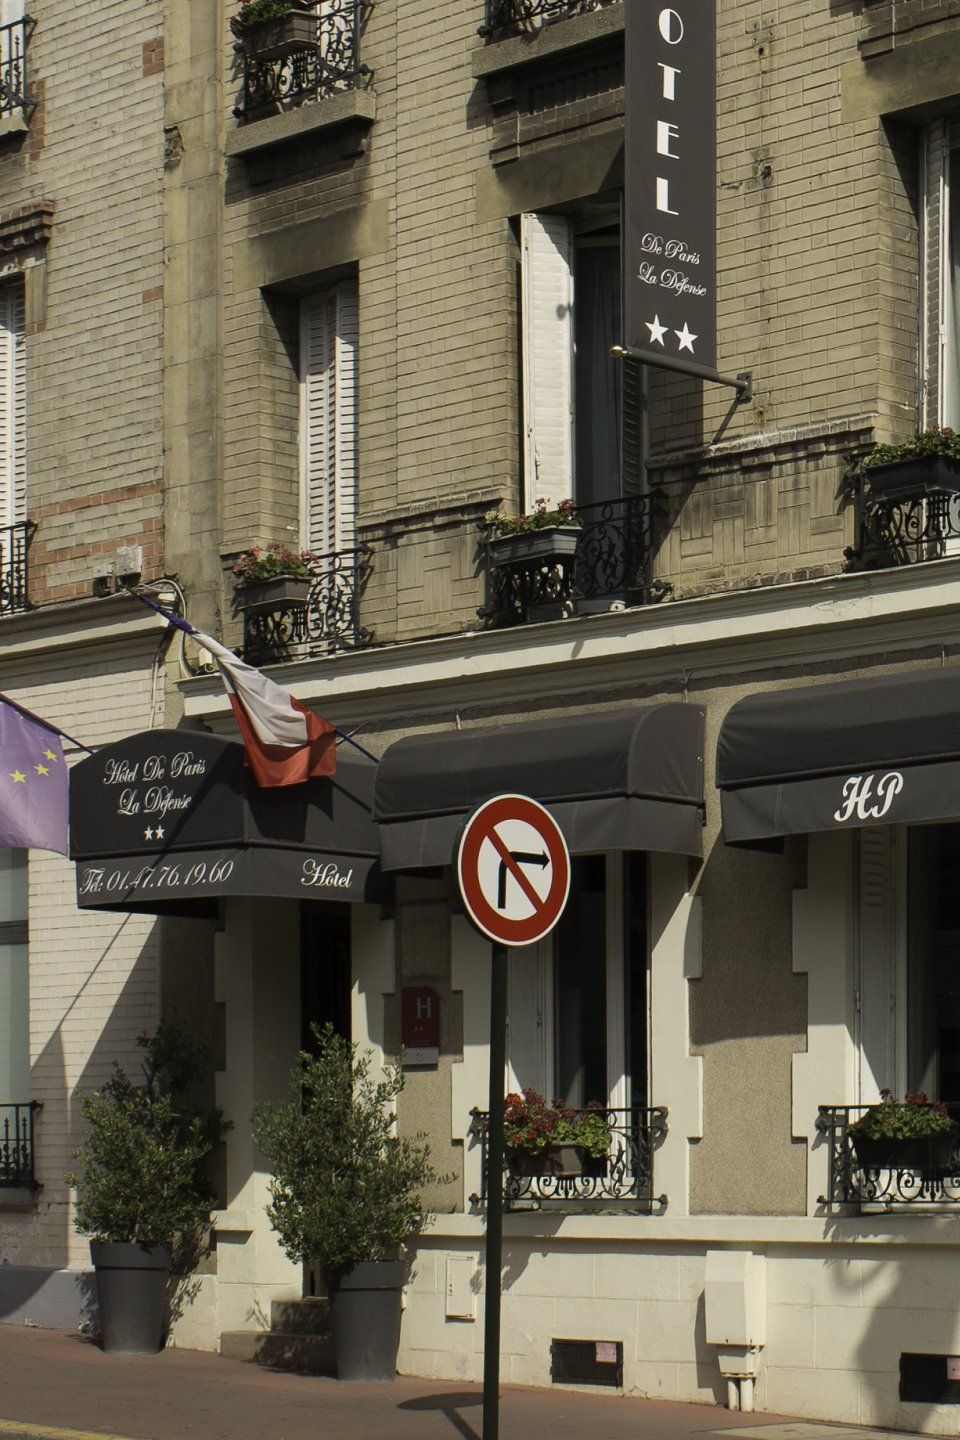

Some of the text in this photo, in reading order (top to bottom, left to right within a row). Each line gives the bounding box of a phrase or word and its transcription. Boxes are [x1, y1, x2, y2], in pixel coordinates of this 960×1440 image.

[640, 233, 701, 265] De Paris
[637, 261, 658, 285] La
[142, 755, 167, 781] De
[170, 751, 207, 778] Paris
[117, 788, 140, 816] La
[834, 771, 905, 823] HP
[300, 858, 354, 889] Hôtel
[416, 996, 432, 1019] H
